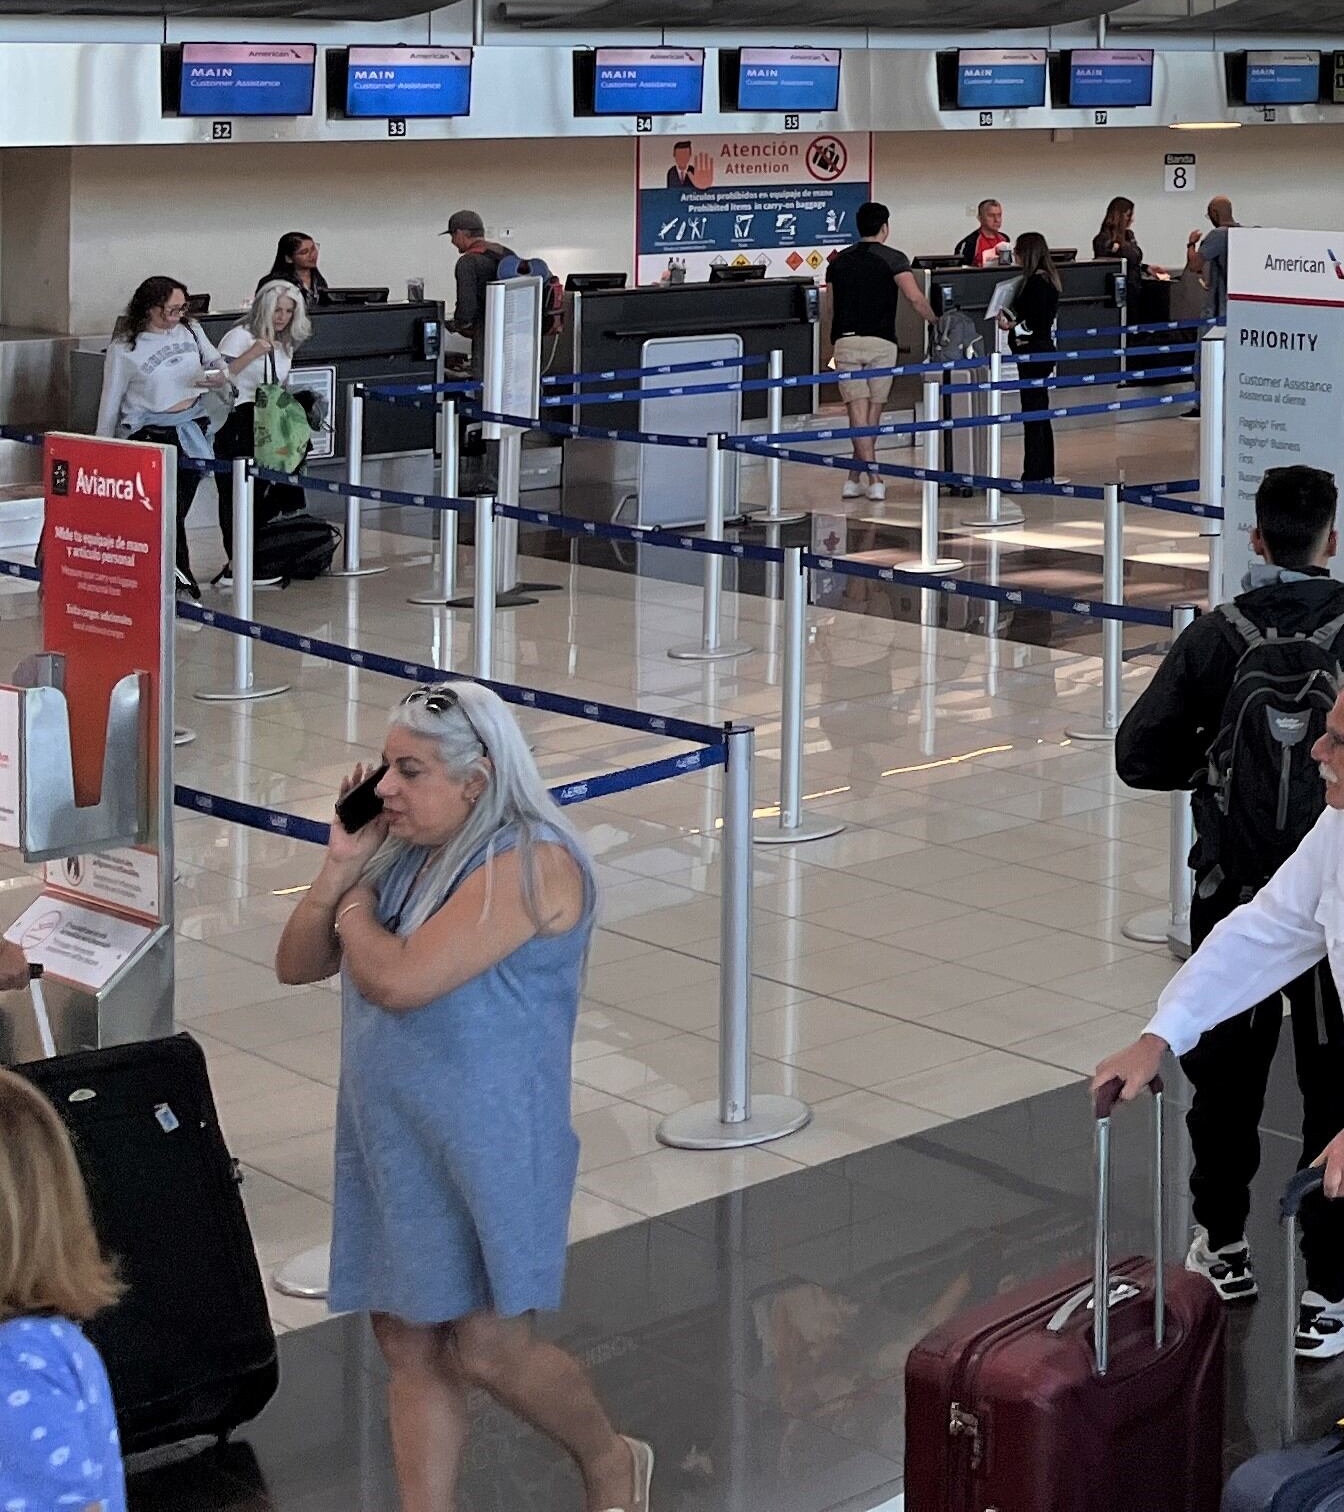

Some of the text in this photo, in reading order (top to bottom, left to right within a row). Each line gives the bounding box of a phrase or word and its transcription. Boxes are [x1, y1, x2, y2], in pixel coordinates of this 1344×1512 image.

[249, 50, 289, 58] American
[409, 52, 449, 60] American
[190, 68, 232, 77] MAIN
[354, 70, 395, 79] MAIN
[601, 70, 637, 79] MAIN
[746, 69, 778, 77] MAIN
[964, 69, 993, 77] MAIN
[1076, 68, 1103, 77] MAIN
[190, 79, 281, 88] Customer Assistance
[637, 117, 651, 130] 34
[785, 116, 798, 129] 35
[980, 113, 992, 125] 36
[1096, 112, 1107, 124] 37
[214, 124, 230, 137] 32
[390, 121, 405, 135] 33
[720, 140, 800, 158] Atención
[725, 162, 790, 175] Attention
[1173, 166, 1187, 189] 8
[1264, 254, 1326, 274] American
[1240, 328, 1319, 352] PRIORITY
[1239, 372, 1333, 393] Customer Assistance
[1282, 395, 1307, 406] cliente
[75, 466, 134, 501] Avianca
[82, 533, 115, 550] equipaje
[115, 535, 126, 550] de
[126, 540, 149, 554] mano
[101, 551, 135, 567] personal
